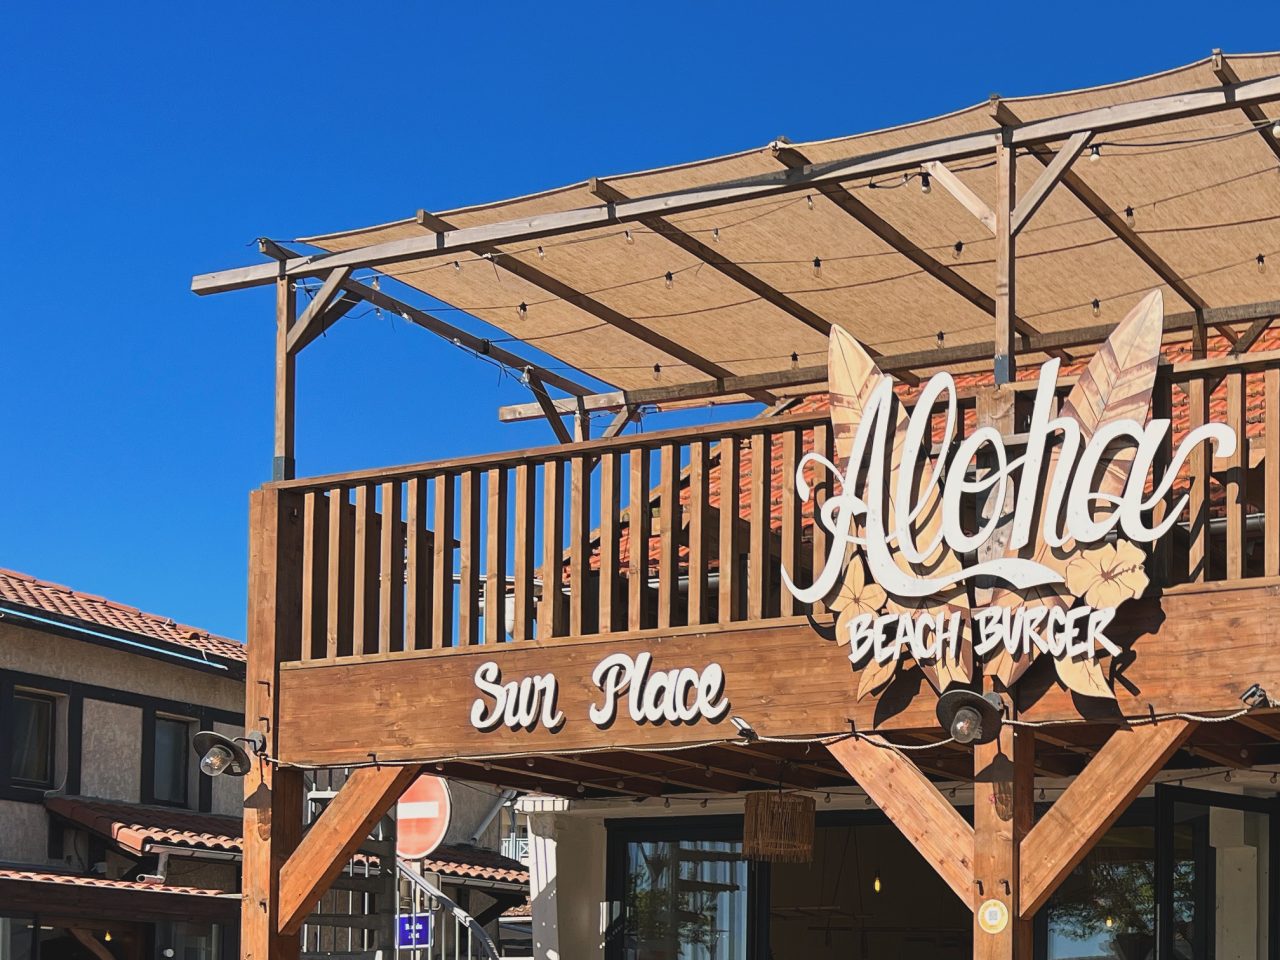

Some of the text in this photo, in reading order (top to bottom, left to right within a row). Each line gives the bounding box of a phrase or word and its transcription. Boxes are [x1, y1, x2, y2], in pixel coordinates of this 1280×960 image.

[781, 357, 1237, 603] Aloha
[846, 605, 1122, 664] BEACH BURGER
[589, 652, 729, 725] Place
